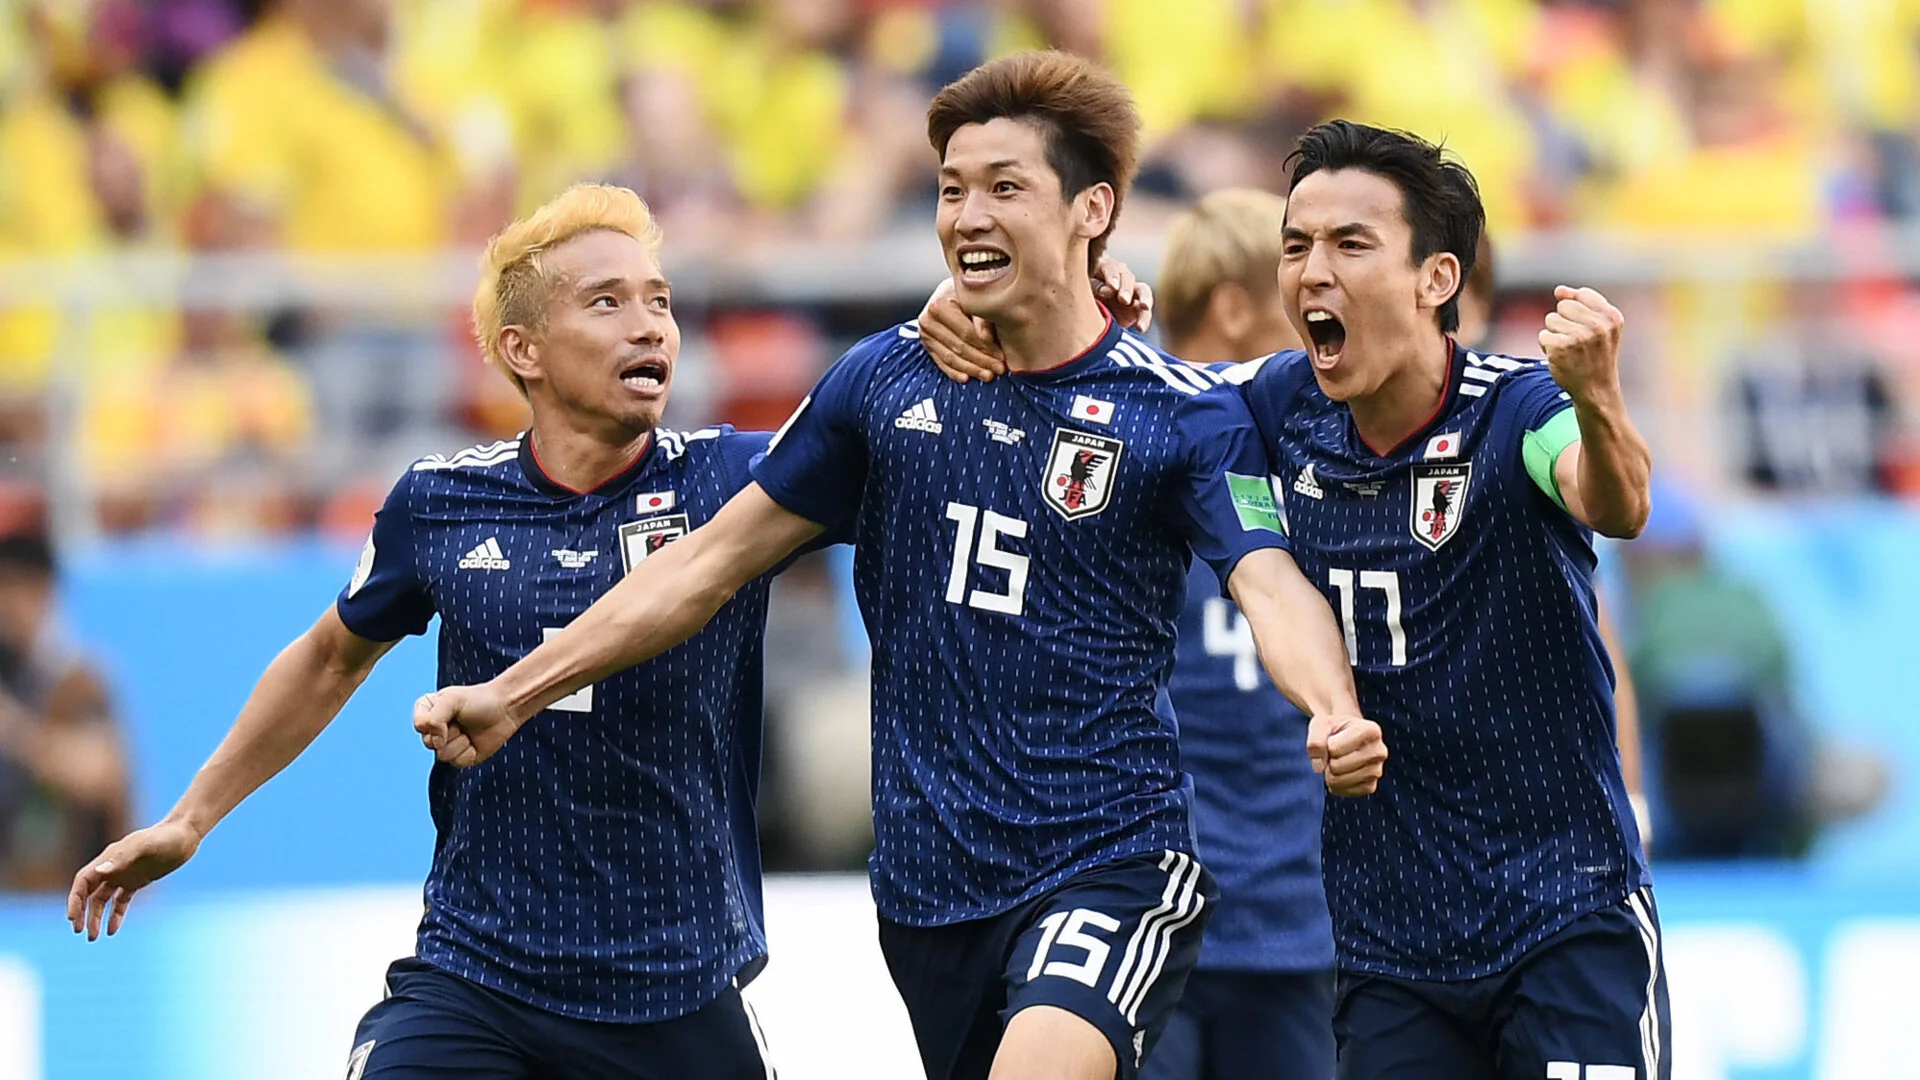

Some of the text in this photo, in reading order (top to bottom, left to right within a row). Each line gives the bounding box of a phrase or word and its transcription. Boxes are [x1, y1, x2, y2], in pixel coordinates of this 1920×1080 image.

[895, 416, 943, 434] adidas
[1071, 434, 1106, 448] JAPAN
[1428, 467, 1460, 476] JAPAN
[1293, 480, 1324, 500] adidas
[636, 519, 671, 532] JAPAN
[458, 557, 511, 571] adidas
[945, 501, 1030, 616] 15
[1329, 568, 1406, 666] 17
[1203, 597, 1259, 690] 4
[1027, 908, 1121, 988] 15
